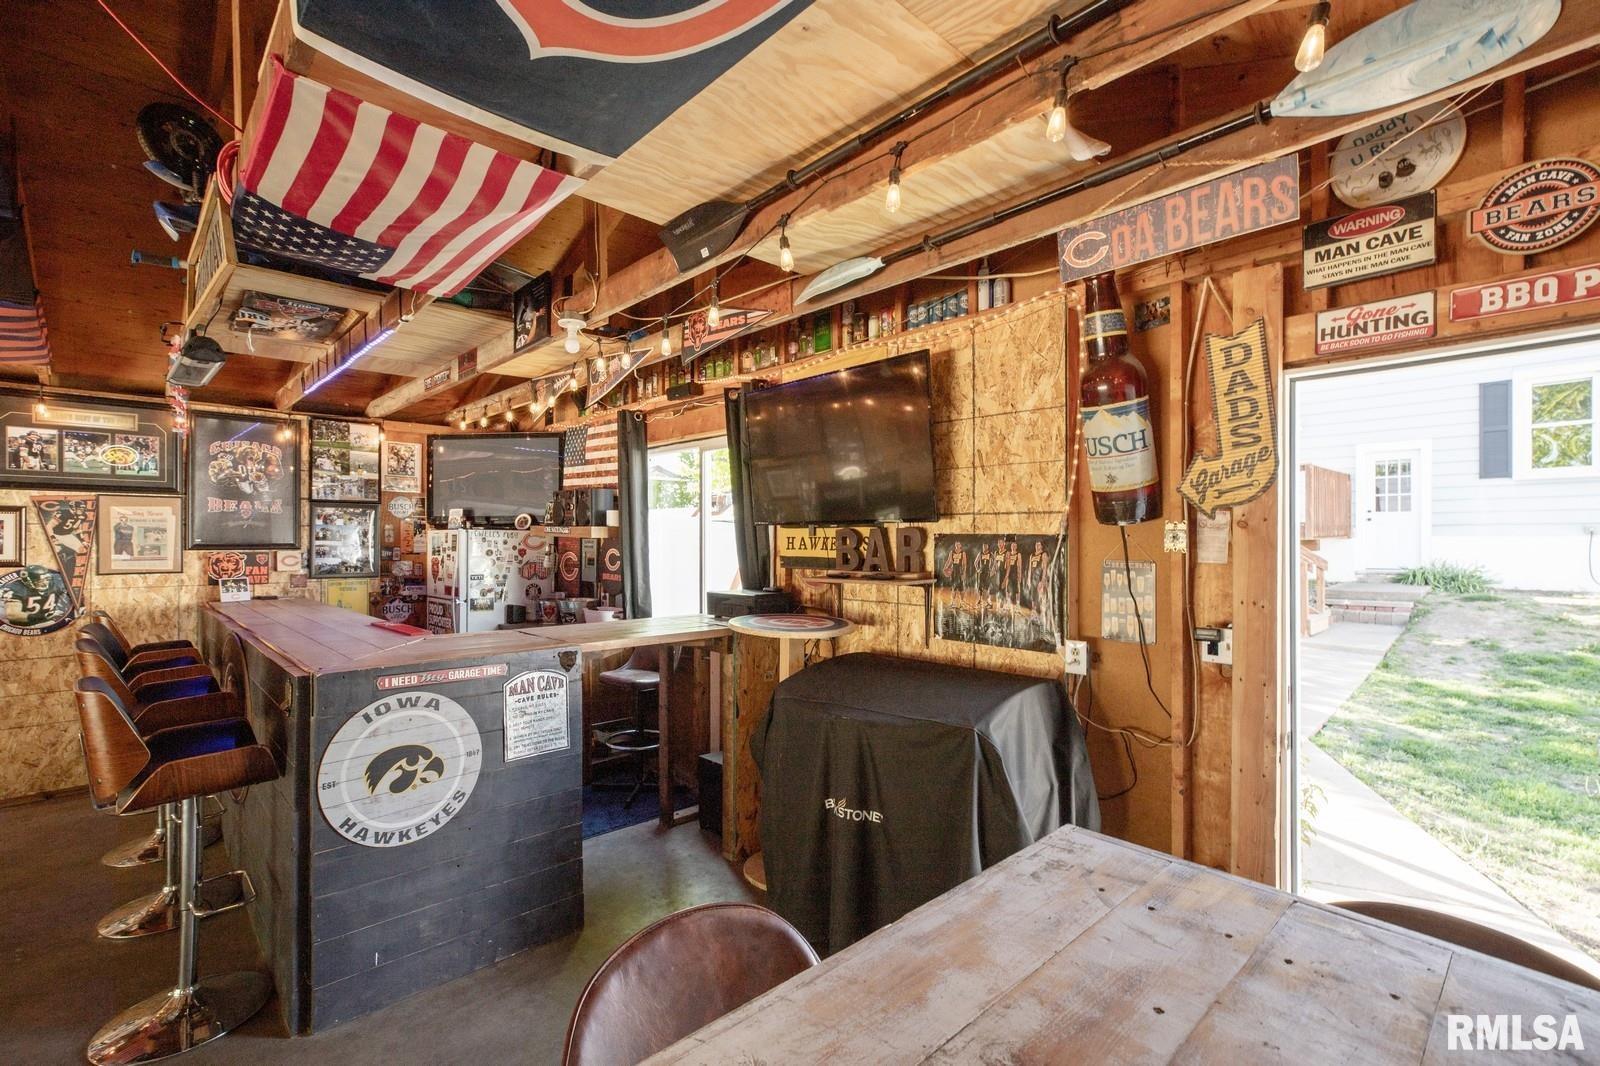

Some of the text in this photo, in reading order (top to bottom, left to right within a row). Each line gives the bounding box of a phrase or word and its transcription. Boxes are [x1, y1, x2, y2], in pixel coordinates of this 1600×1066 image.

[1505, 171, 1574, 196] MAN CAVE
[1111, 213, 1158, 265] DA
[1164, 175, 1295, 251] BEARS
[1485, 186, 1595, 225] BEARS
[1333, 209, 1401, 235] WARNING
[1505, 218, 1573, 241] FAN ZONE
[1306, 266, 1326, 276] WHAT
[1327, 259, 1361, 270] HAPPENS
[1374, 252, 1388, 260] THE
[1390, 247, 1409, 256] MAN
[1410, 241, 1432, 250] CAVE
[1315, 225, 1422, 263] MAN CAVE
[1322, 271, 1344, 279] STAYS
[1355, 264, 1368, 272] THE
[1370, 260, 1389, 268] MAN
[1390, 255, 1411, 264] CAVE
[1480, 276, 1559, 313] BBQ
[1320, 311, 1429, 341] HUNTING
[1347, 304, 1400, 328] Gone
[1320, 343, 1328, 351] BE
[1330, 341, 1348, 349] BACK
[1350, 338, 1369, 346] SOON
[1371, 335, 1380, 343] TO
[1394, 328, 1428, 339] FISHING!
[1190, 446, 1272, 504] Garage
[836, 527, 922, 572] BAR
[384, 678, 389, 687] I
[391, 675, 418, 687] NEED
[448, 668, 480, 680] GARAGE
[483, 665, 502, 676] TIME
[508, 675, 564, 696] MAN CAVE
[361, 695, 441, 724] IOWA
[321, 781, 336, 790] EST
[338, 789, 467, 845] HAWKEYES
